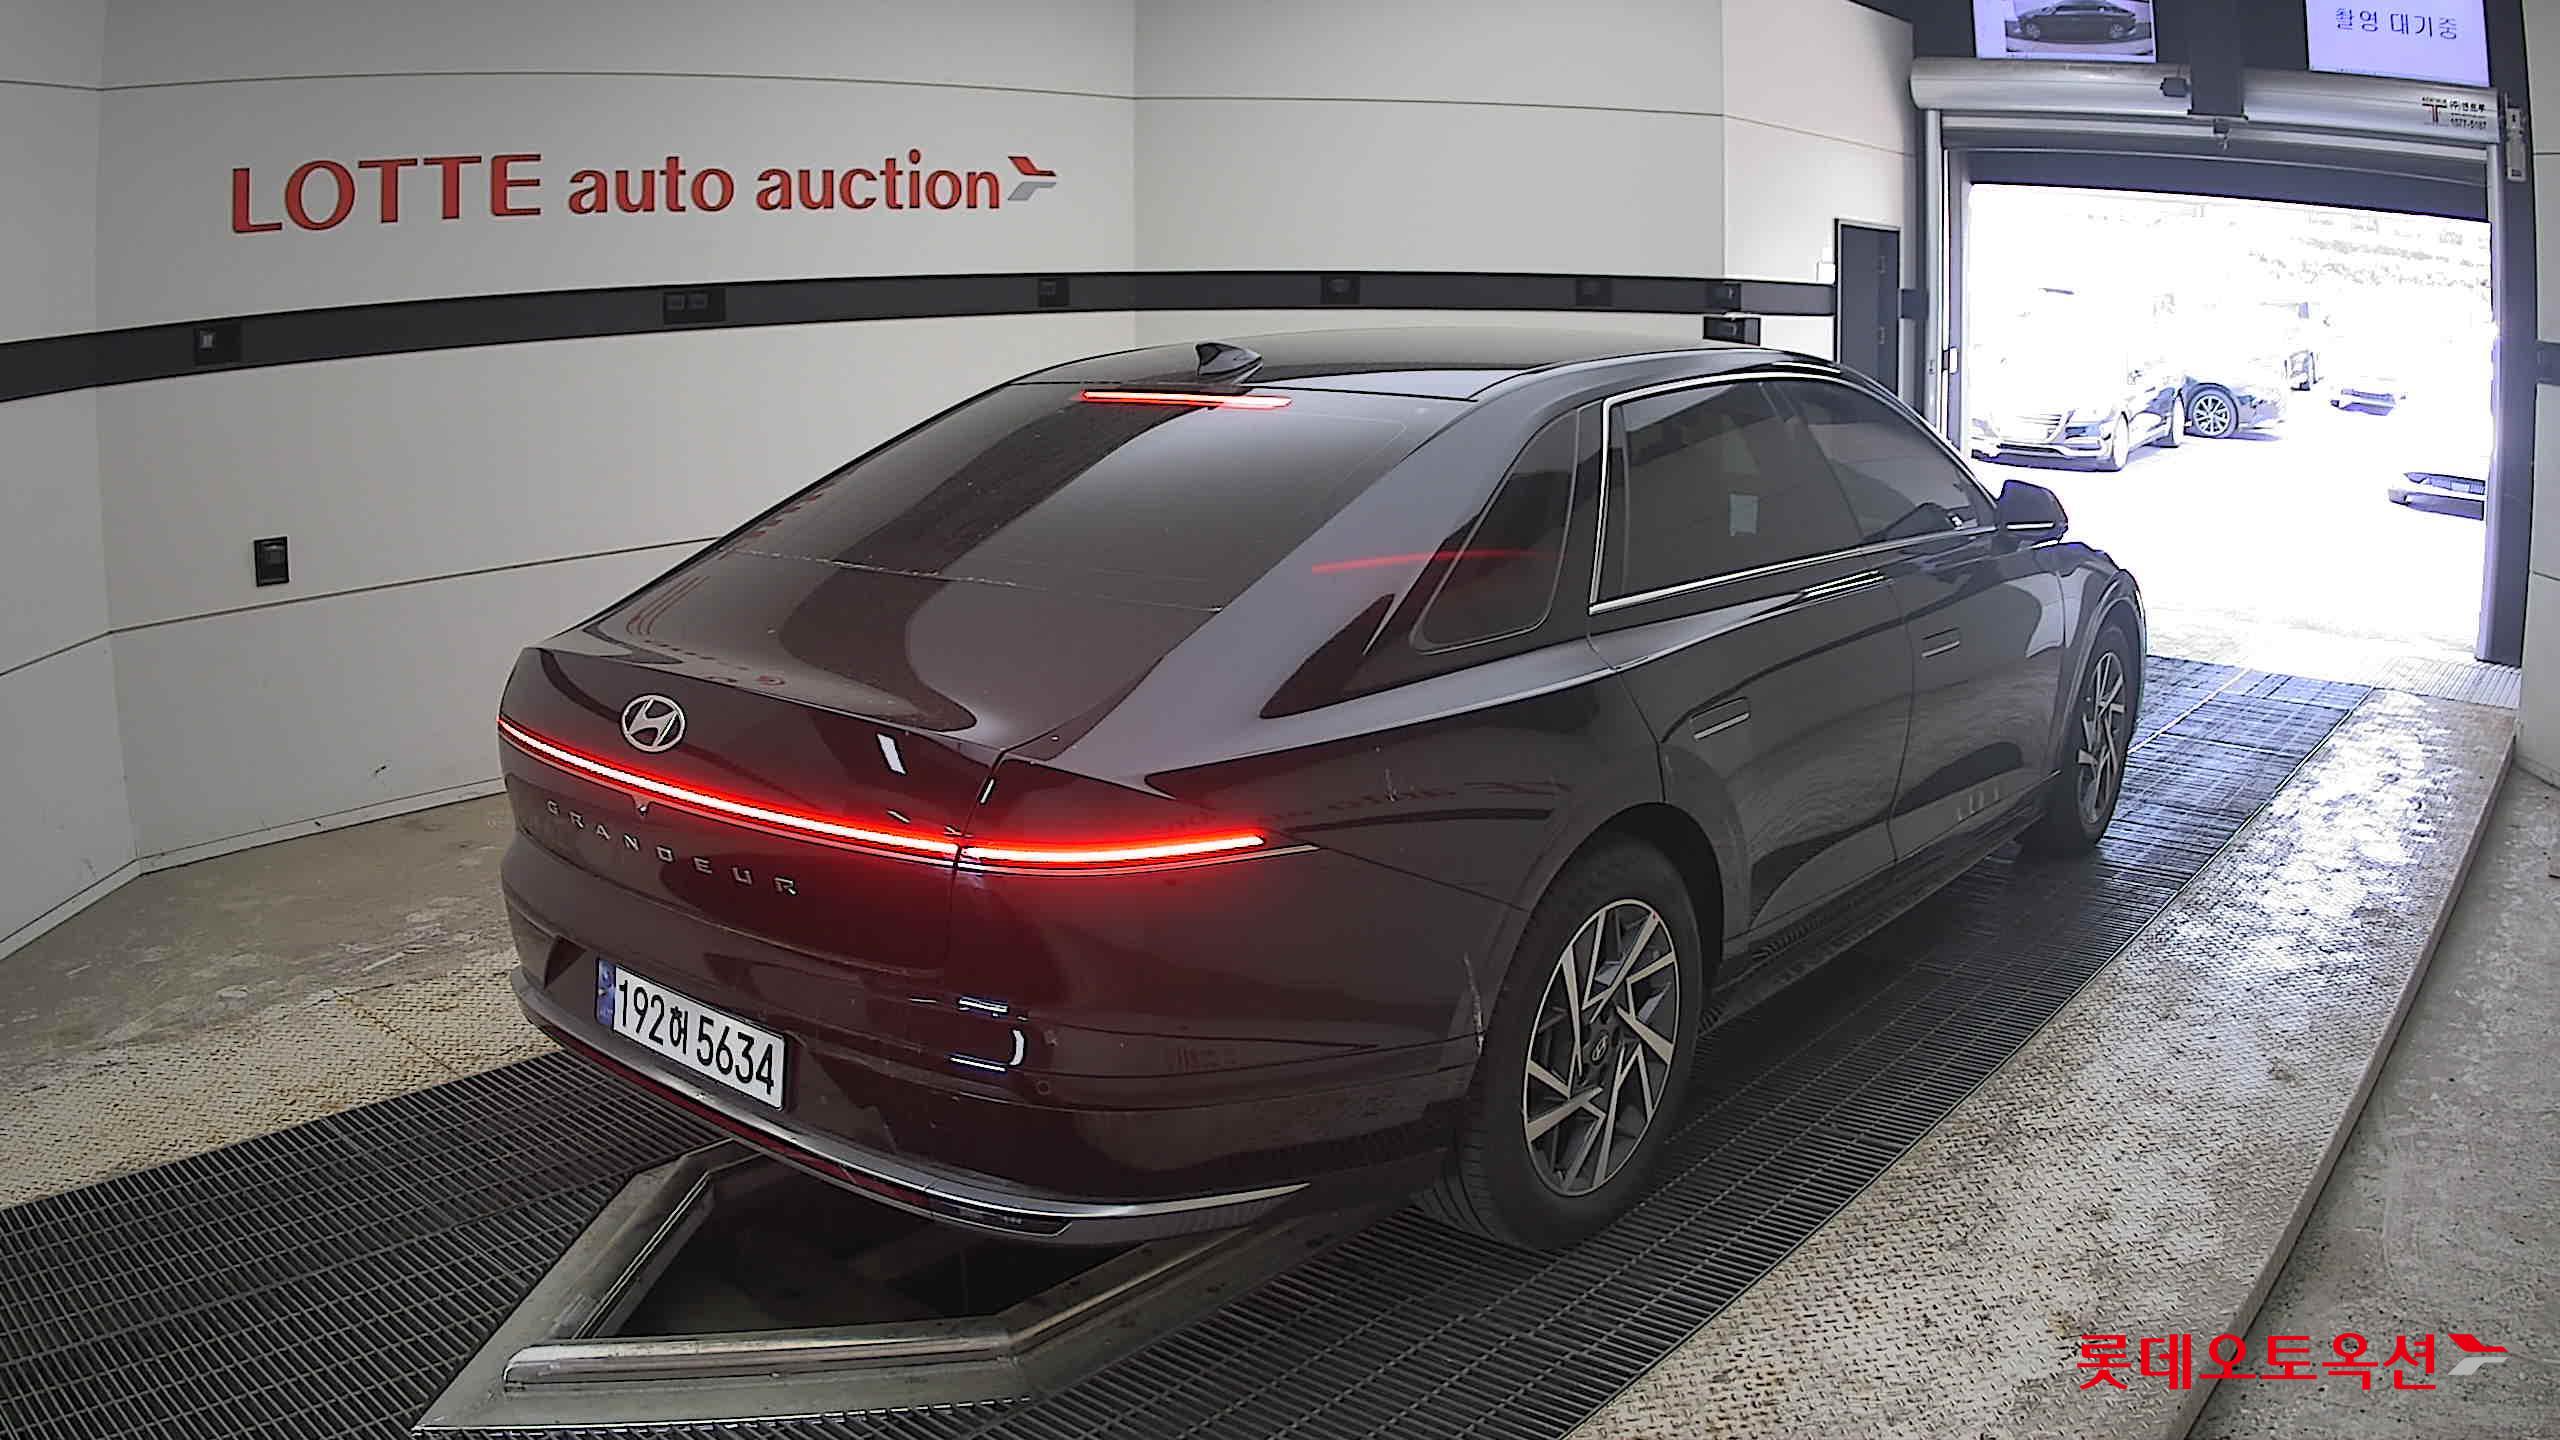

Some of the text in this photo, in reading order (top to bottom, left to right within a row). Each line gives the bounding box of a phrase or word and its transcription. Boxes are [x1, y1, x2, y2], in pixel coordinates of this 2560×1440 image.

[233, 148, 1001, 233] LOTTE auto auction
[547, 800, 797, 895] GRANDEUR
[619, 979, 775, 1095] 192허 5634
